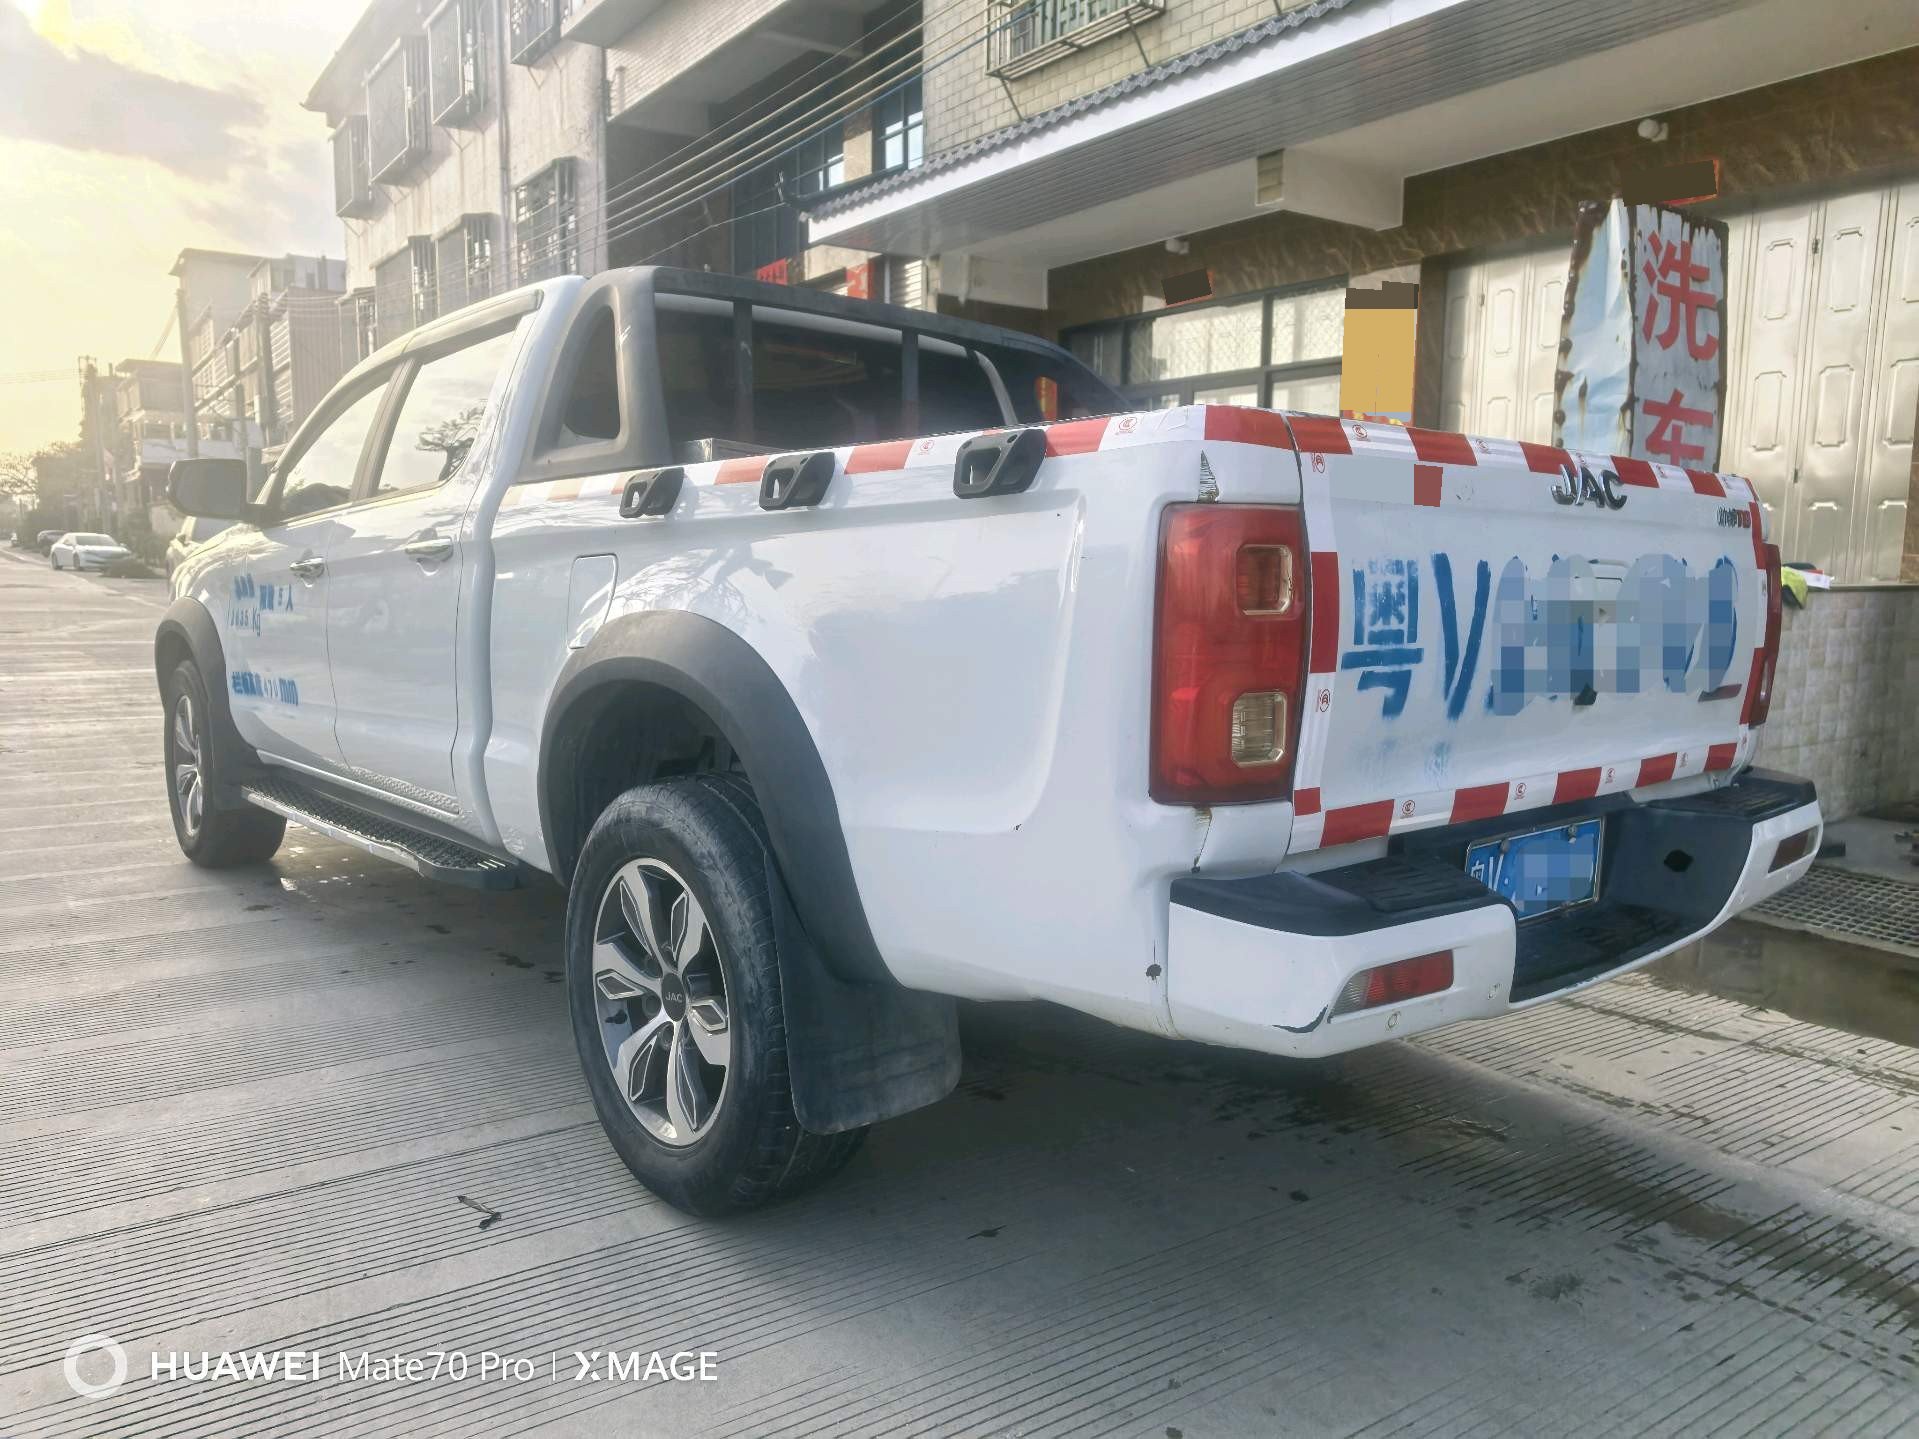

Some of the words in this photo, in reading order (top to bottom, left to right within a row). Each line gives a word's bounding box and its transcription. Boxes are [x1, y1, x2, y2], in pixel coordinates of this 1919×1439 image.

[1642, 230, 1719, 467] 洗车
[1551, 463, 1628, 511] JAC
[665, 991, 682, 1003] JAC
